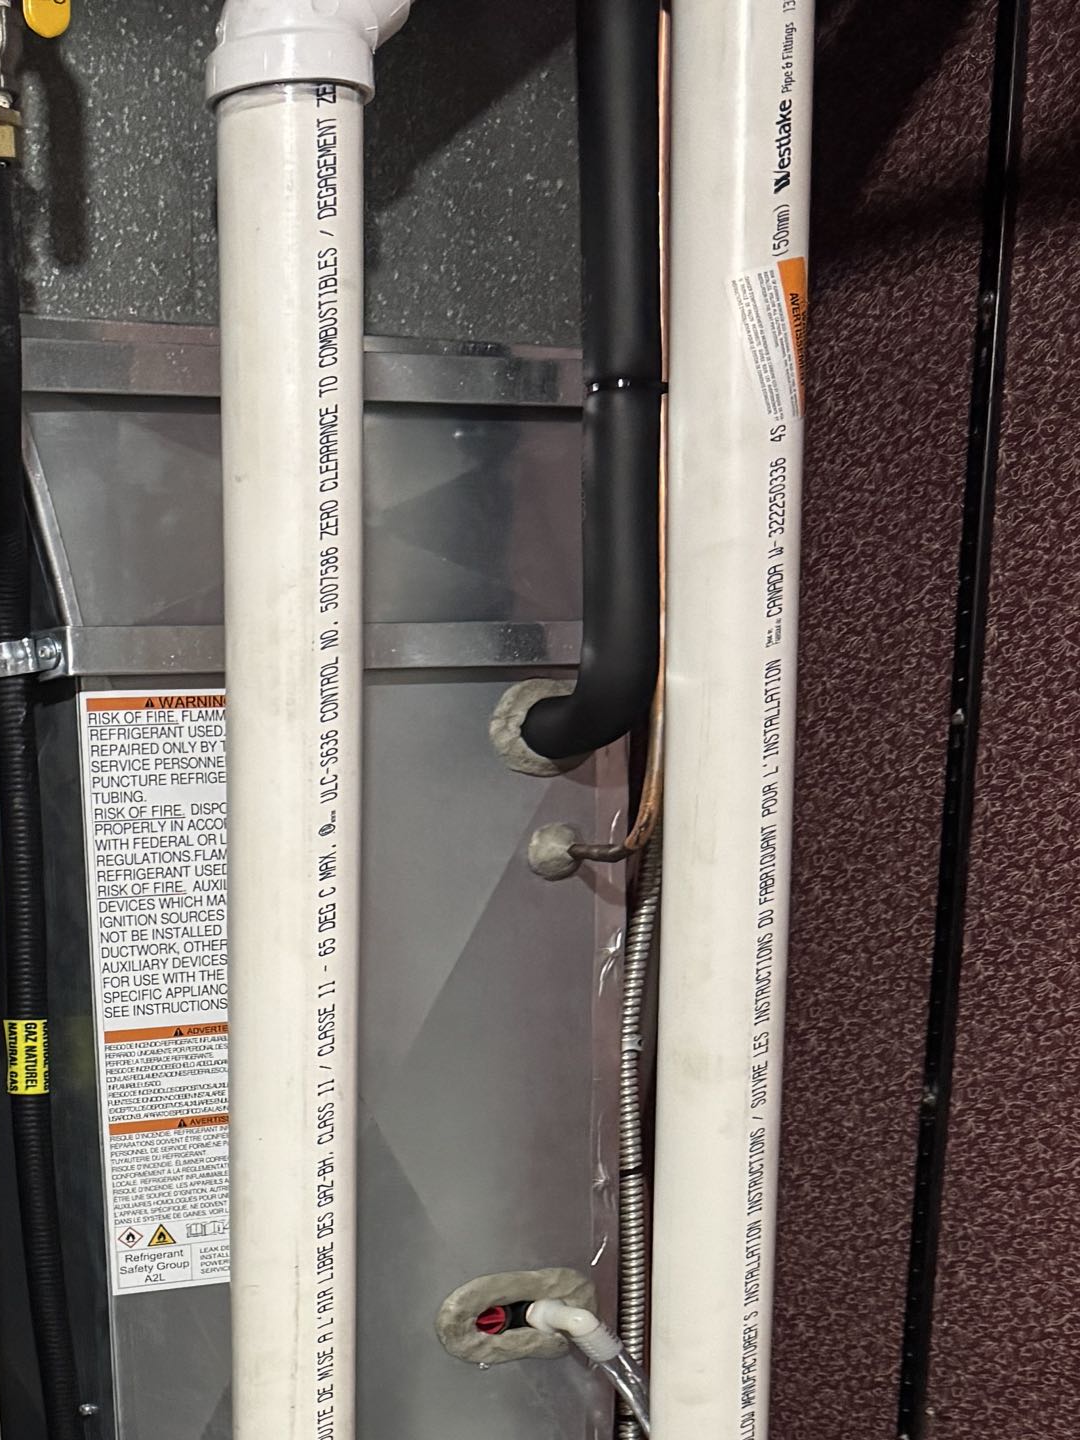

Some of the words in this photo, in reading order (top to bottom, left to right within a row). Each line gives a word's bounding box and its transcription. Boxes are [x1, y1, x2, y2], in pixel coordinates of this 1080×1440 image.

[782, 22, 797, 60] Fittings
[781, 71, 796, 94] Pipe
[774, 99, 793, 194] Westlake
[316, 118, 338, 220] DEGAGEMENT
[774, 204, 790, 256] (50mm)
[318, 248, 339, 368] COMBUSTIBLES
[318, 376, 339, 398] TO
[318, 404, 339, 492] CLEARANCE
[319, 500, 339, 541] ZERO
[319, 547, 339, 613] 5007586
[765, 563, 783, 618] CANADA
[319, 621, 339, 649] NO.
[319, 656, 339, 723] CONTROL
[88, 712, 120, 725] RISK
[124, 711, 142, 724] OF
[146, 710, 178, 723] FIRE.
[762, 659, 781, 778] L'INSTALLATION
[90, 726, 184, 741] REFRIGERANT
[90, 743, 159, 757] REPAIRED
[163, 741, 197, 754] ONLY
[200, 741, 217, 752] BY
[91, 758, 150, 773] SERVICE
[319, 730, 339, 802] ULC-S636
[92, 774, 167, 789] PUNCTURE
[92, 791, 147, 805] TUBING.
[762, 783, 778, 817] POUR
[94, 807, 125, 820] RISK
[129, 806, 147, 819] OF
[151, 804, 185, 817] FIRE.
[95, 821, 166, 836] PROPERLY
[170, 820, 183, 832] IN
[95, 838, 129, 851] WITH
[133, 835, 194, 849] FEDERAL
[197, 834, 217, 846] OR
[97, 866, 191, 882] REFRIGERANT
[319, 844, 339, 880] MAX.
[758, 823, 777, 905] FABRIQUANT
[99, 898, 155, 913] DEVICES
[159, 896, 203, 909] WHICH
[317, 887, 336, 897] C
[99, 914, 157, 929] IGNITION
[161, 909, 225, 925] SOURCES
[317, 903, 336, 931] DEG
[758, 909, 774, 928] DU
[100, 930, 127, 944] NOT
[131, 929, 148, 941] BE
[152, 925, 222, 940] INSTALLED
[101, 942, 180, 958] DUCTWORK,
[317, 938, 336, 957] 65
[102, 958, 169, 974] AUXILIARY
[172, 954, 228, 968] DEVICES
[103, 976, 130, 989] FOR
[133, 974, 159, 986] USE
[163, 971, 195, 984] WITH
[199, 969, 225, 982] THE
[754, 933, 773, 1026] INSTRUCTIONS
[103, 988, 162, 1004] SPECIFIC
[104, 1005, 129, 1018] SEE
[133, 998, 228, 1016] INSTRUCTIONS
[25, 1022, 37, 1042] GAZ
[317, 1003, 336, 1057] CLASSE
[8, 1022, 18, 1068] NATURAL
[753, 1032, 769, 1057] LES
[25, 1046, 37, 1090] NATUREL
[9, 1071, 18, 1091] GAS
[751, 1061, 768, 1109] SUIVRE
[317, 1103, 336, 1145] CLASS
[747, 1128, 765, 1216] INSTRUCTIONS
[317, 1212, 336, 1237] DES
[120, 1264, 153, 1275] Safety
[156, 1260, 190, 1271] Group
[125, 1249, 184, 1263] Refrigerant
[317, 1241, 335, 1281] LIBRE
[744, 1220, 762, 1306] INSTALLATION
[145, 1274, 166, 1283] A2L
[317, 1287, 335, 1325] L'AIR
[317, 1333, 335, 1344] A
[317, 1348, 335, 1380] MISE
[740, 1311, 758, 1408] MANUFACTURER'S
[317, 1384, 335, 1404] DE
